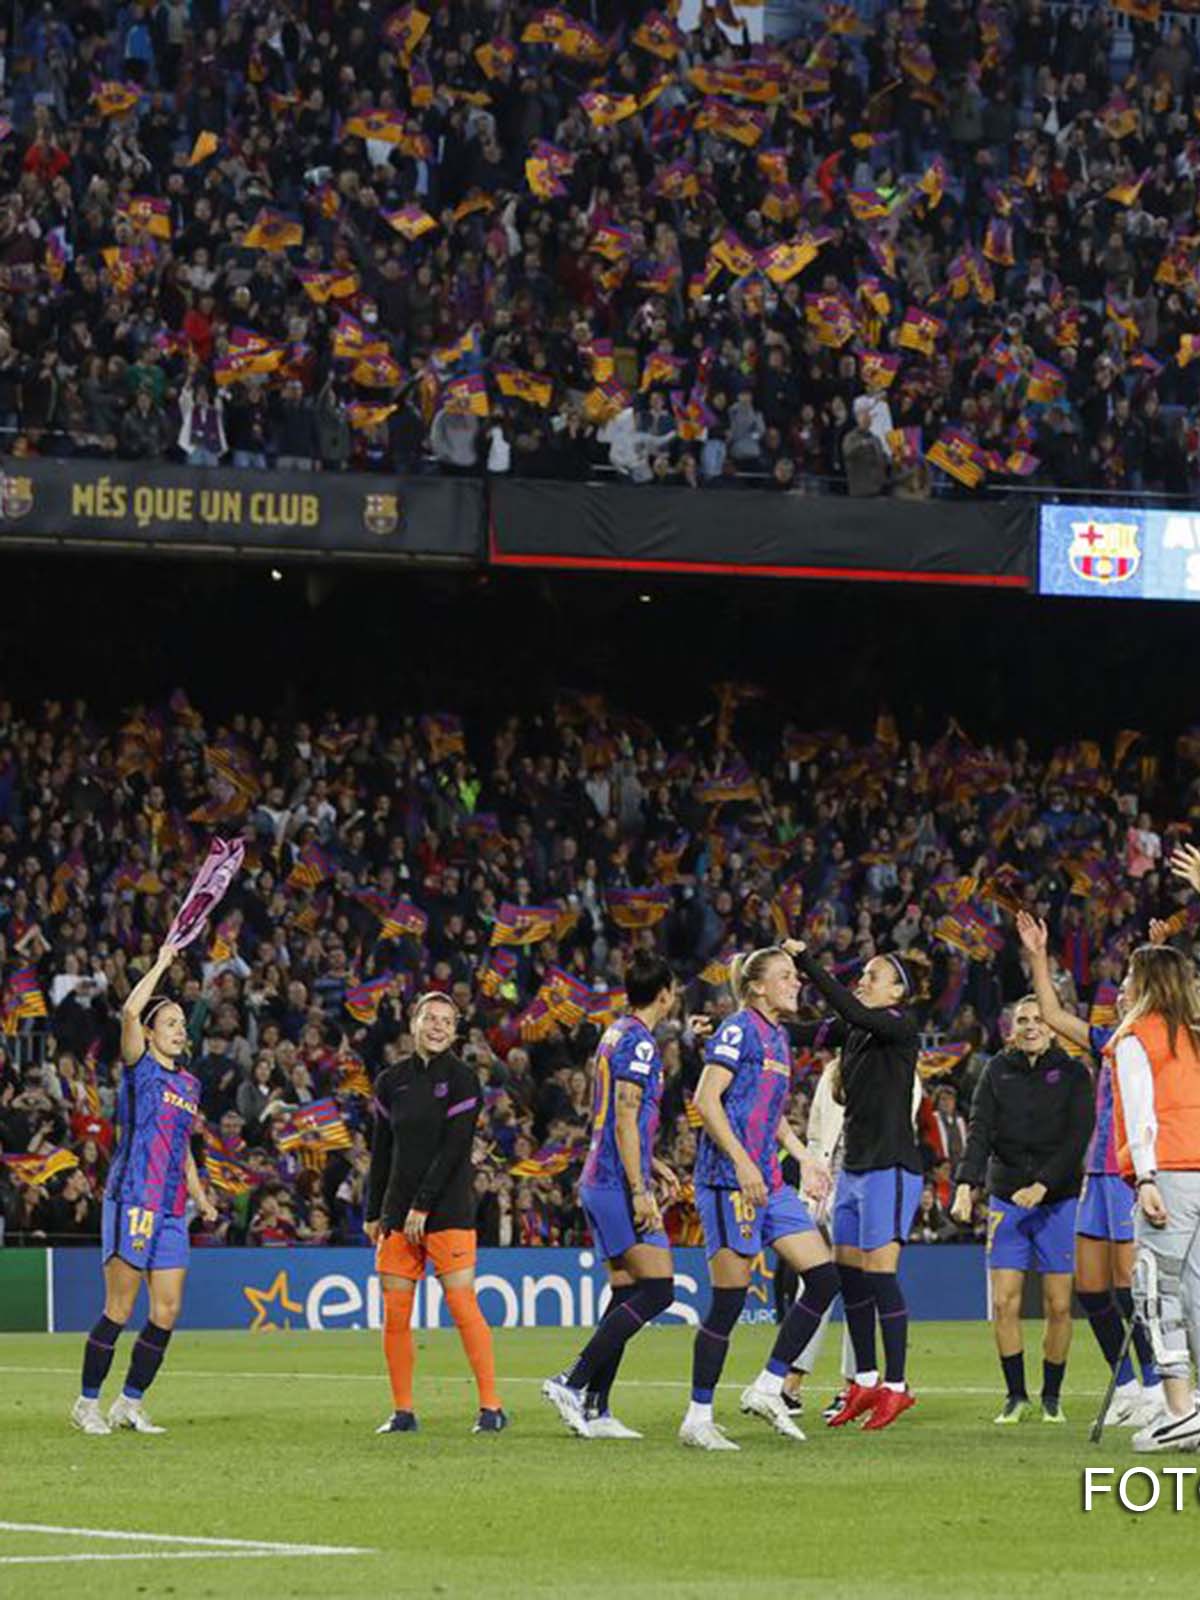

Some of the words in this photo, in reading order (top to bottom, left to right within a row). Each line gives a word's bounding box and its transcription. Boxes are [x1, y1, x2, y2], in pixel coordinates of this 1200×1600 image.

[72, 476, 127, 517] MÉS
[133, 486, 192, 527] QUE
[200, 489, 244, 522] UN
[249, 493, 320, 526] CLUB
[127, 1206, 154, 1239] 14
[306, 1251, 702, 1330] eronis
